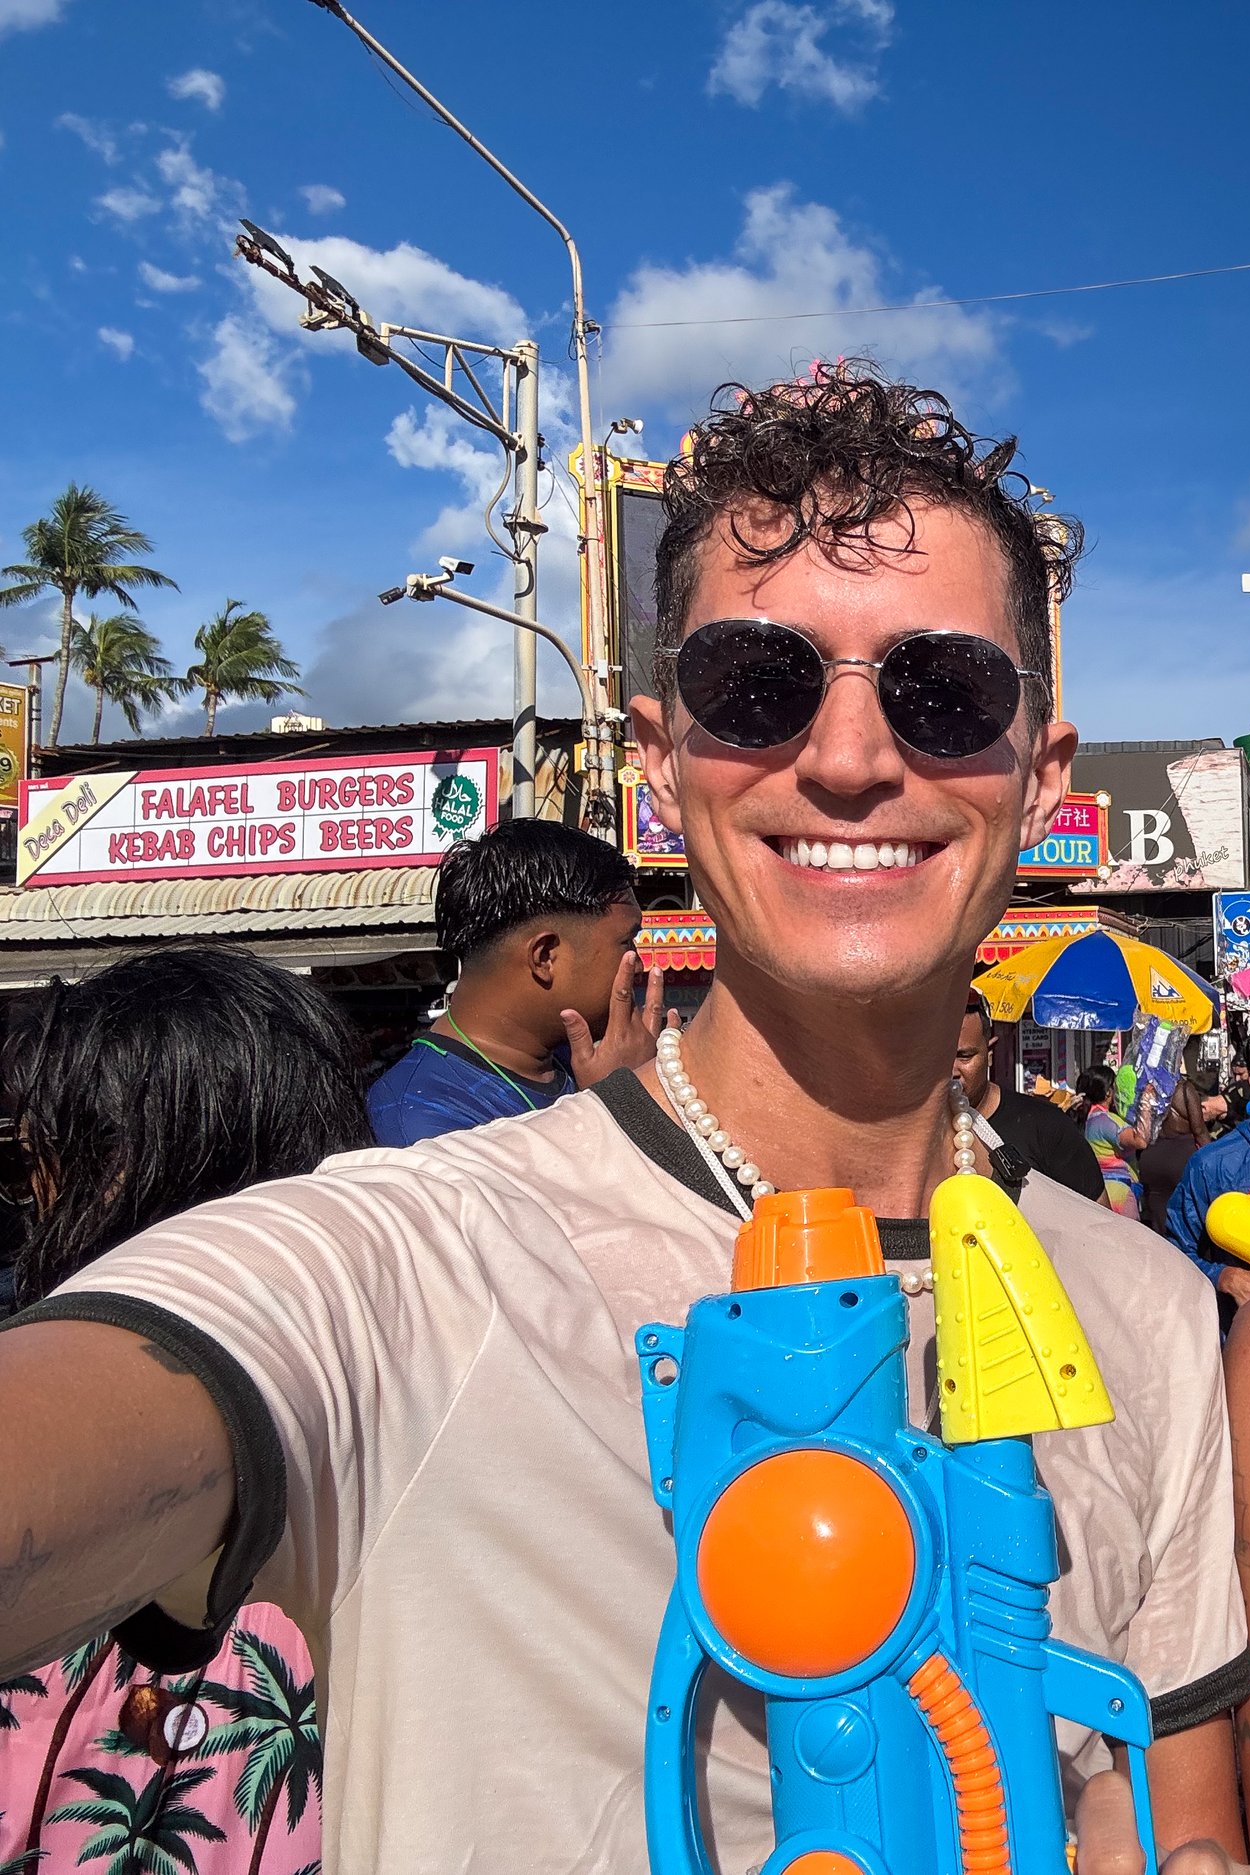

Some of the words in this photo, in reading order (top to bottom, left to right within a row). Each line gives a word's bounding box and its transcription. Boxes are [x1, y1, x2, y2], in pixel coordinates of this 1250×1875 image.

[142, 783, 254, 820] FALAFEL
[277, 772, 415, 811] BURGERS
[434, 797, 473, 818] HALAL
[23, 818, 66, 861] Deca
[61, 781, 98, 826] Deli
[440, 810, 465, 824] FOOD
[1055, 807, 1091, 828] 行社
[108, 828, 195, 864] KEBAB
[207, 822, 296, 858] CHIPS
[319, 815, 414, 851] BEERS
[1174, 845, 1230, 882] phuket
